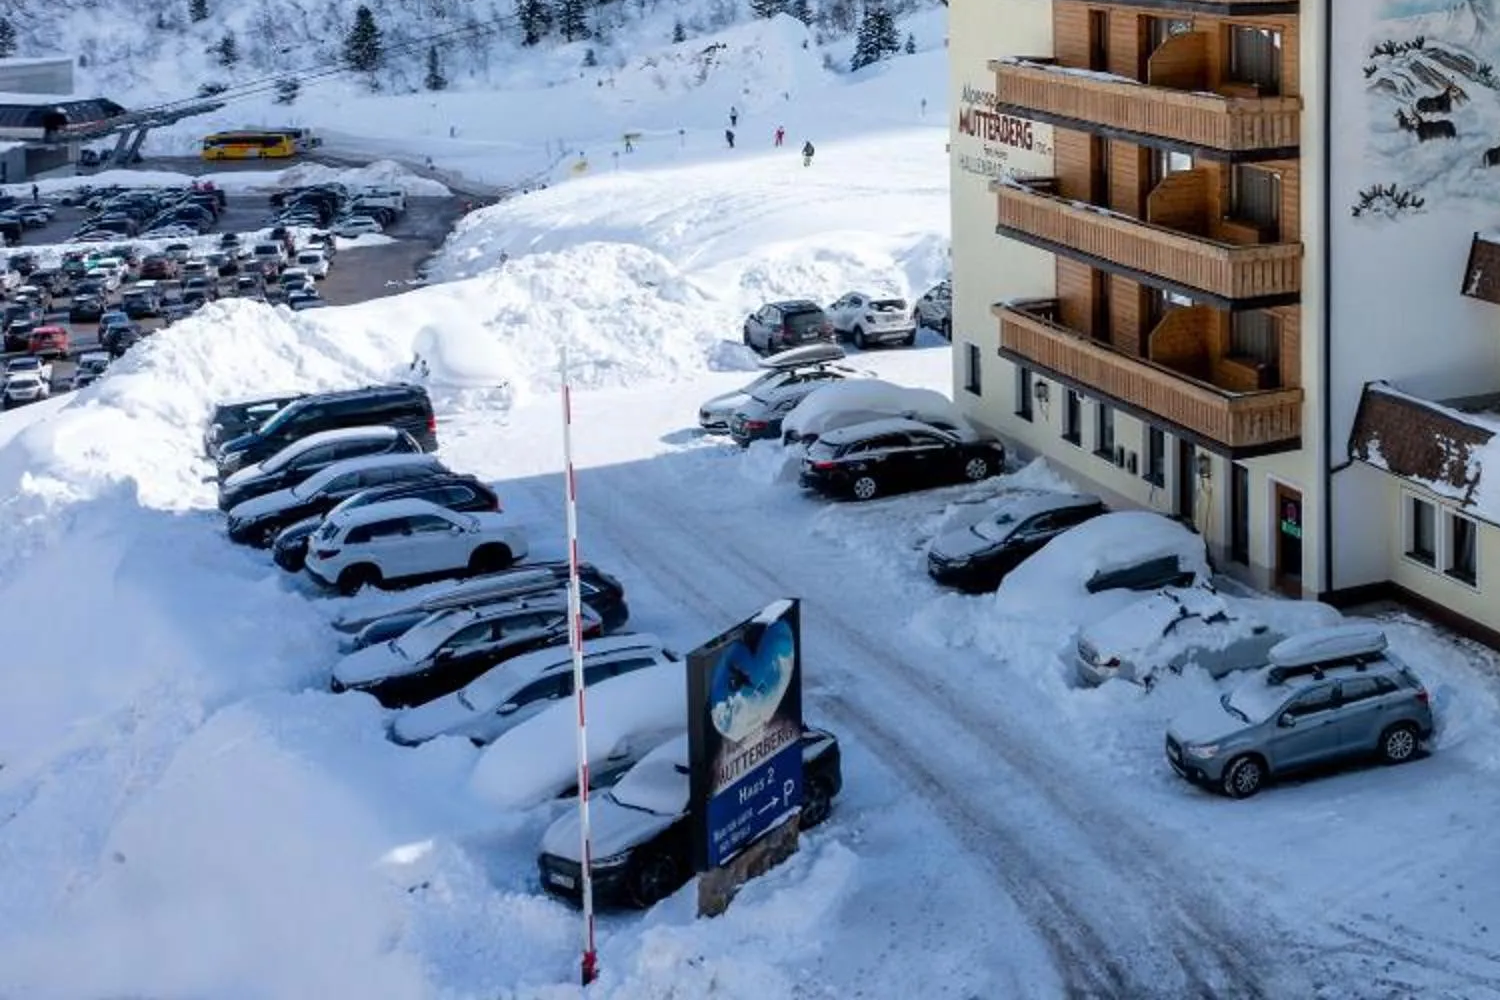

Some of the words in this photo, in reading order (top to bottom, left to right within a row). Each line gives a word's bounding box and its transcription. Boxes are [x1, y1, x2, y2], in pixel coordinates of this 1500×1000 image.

[959, 107, 1033, 151] MUTTERBERG
[738, 775, 766, 805] Haus
[767, 766, 776, 785] 2
[783, 778, 796, 807] P
